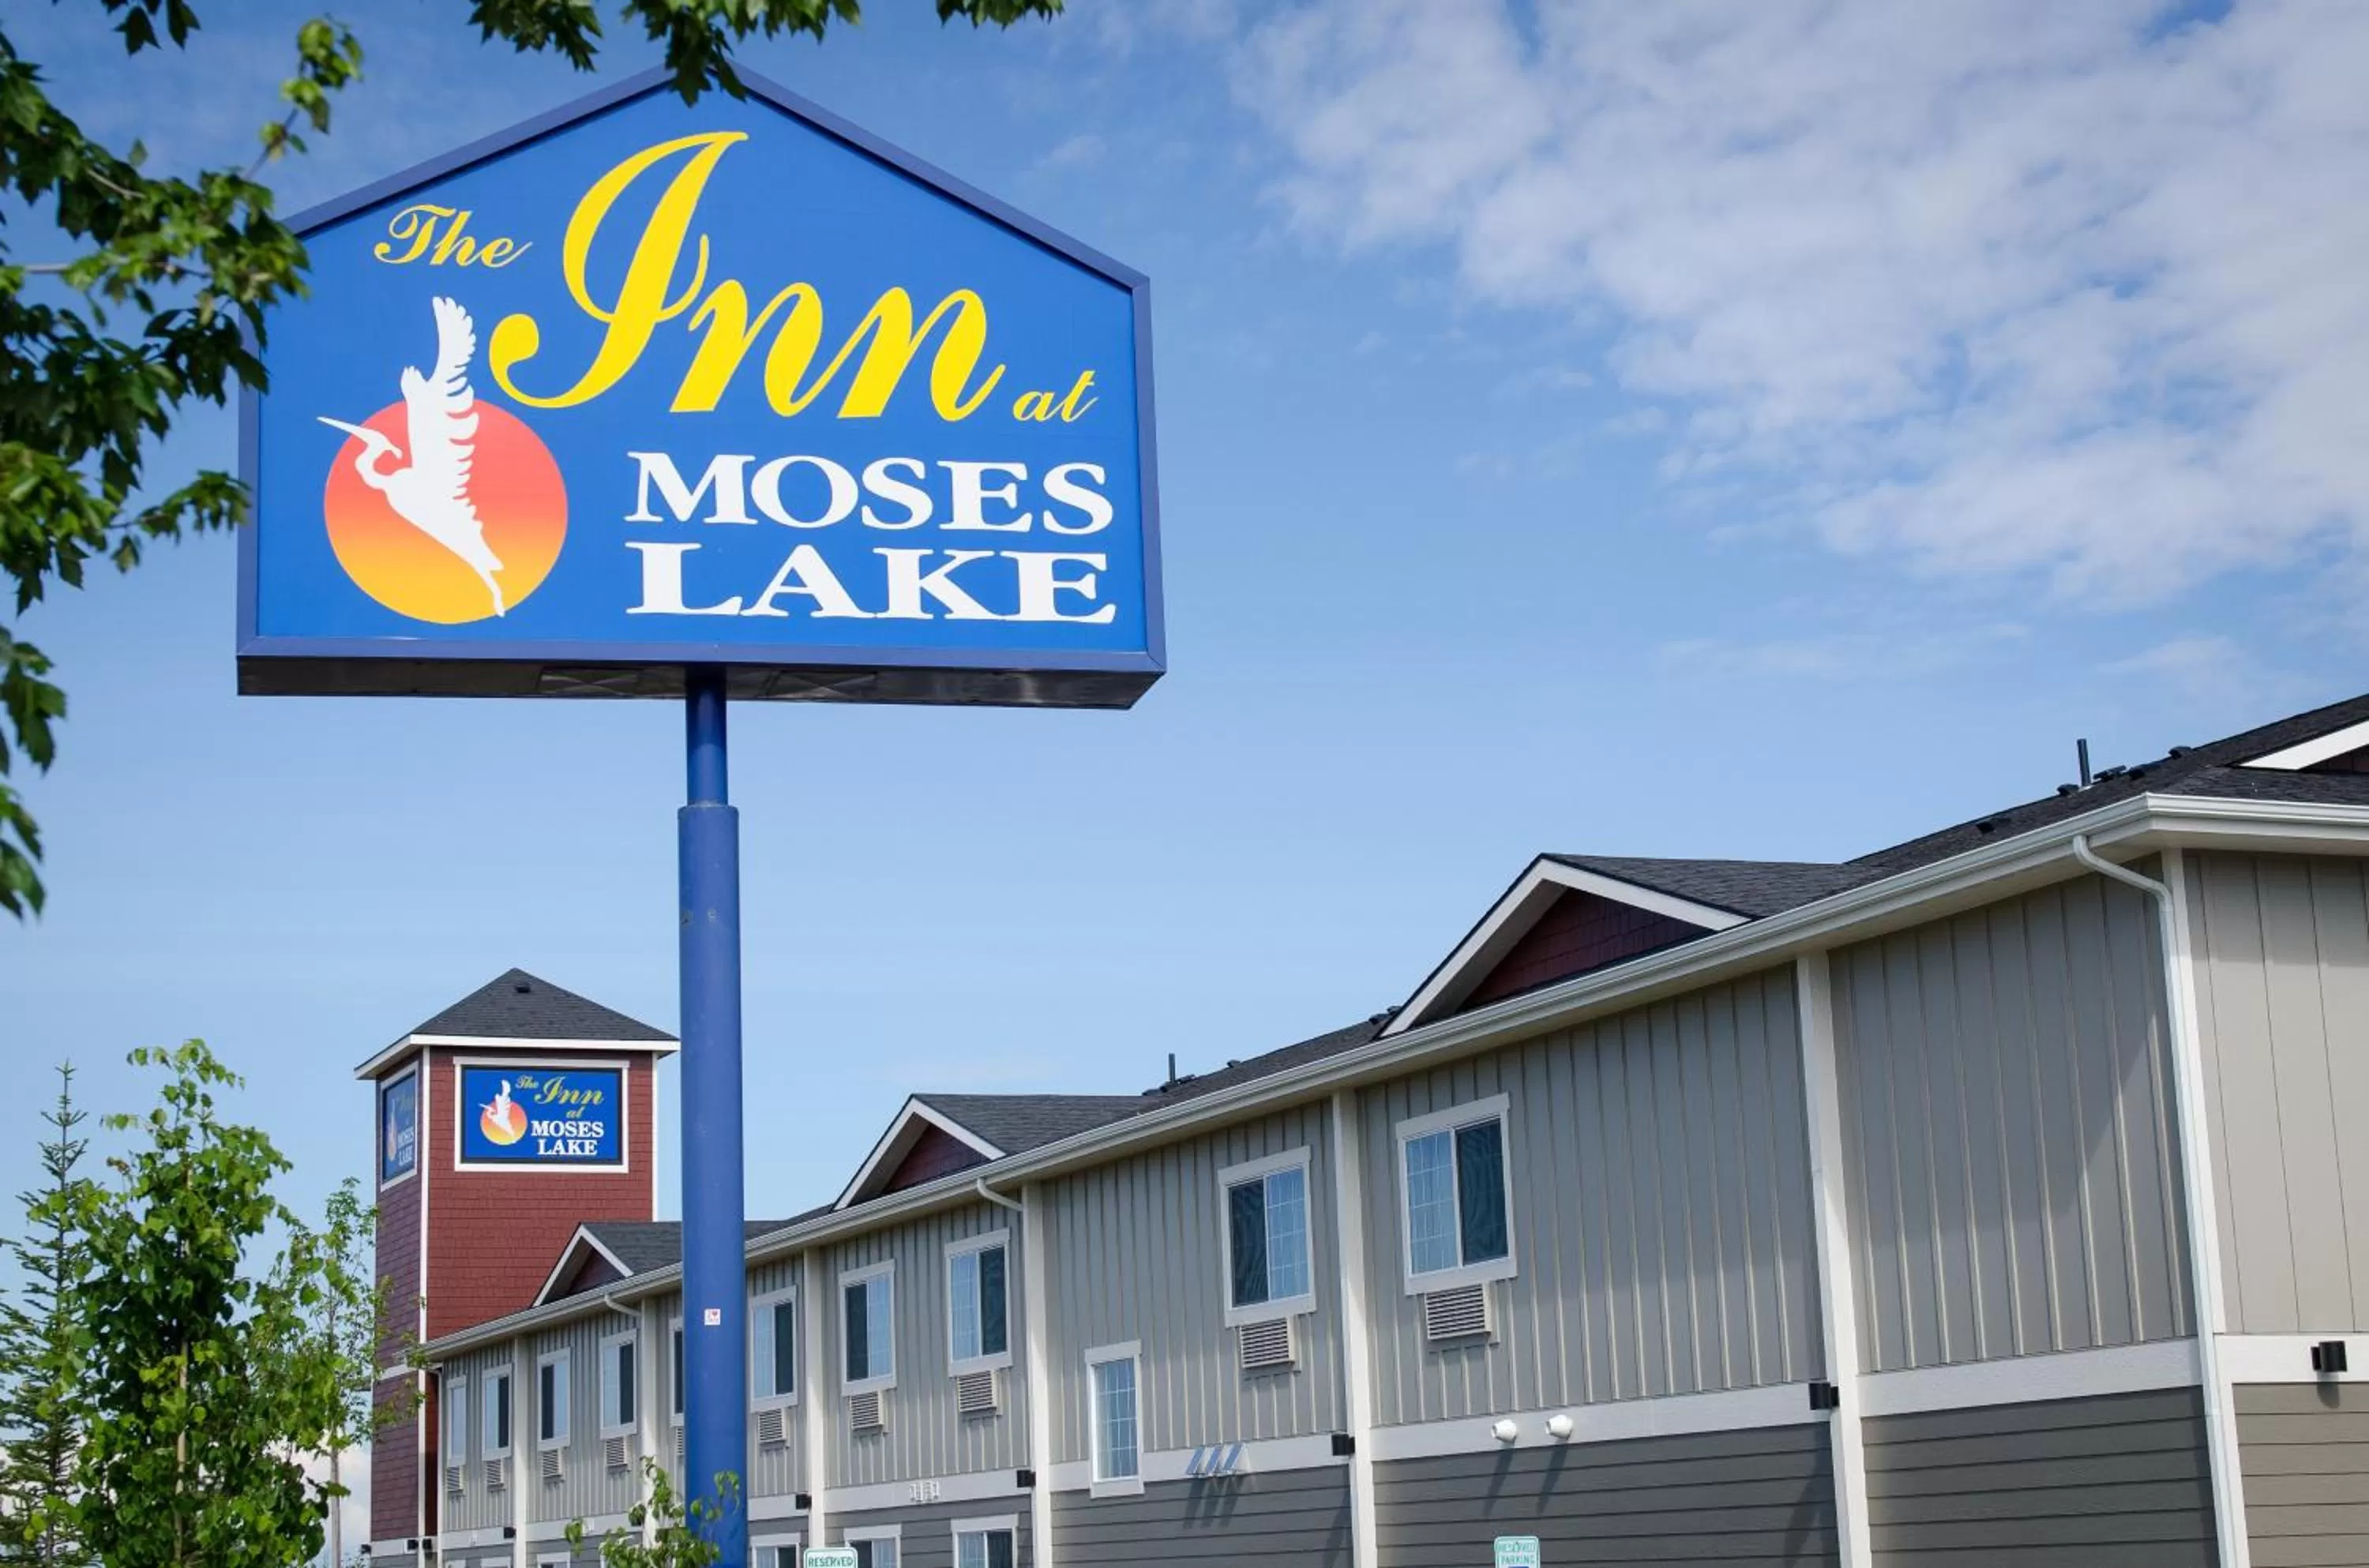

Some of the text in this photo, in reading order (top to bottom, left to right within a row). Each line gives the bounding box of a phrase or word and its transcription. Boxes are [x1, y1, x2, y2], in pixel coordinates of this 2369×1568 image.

[374, 131, 1096, 423] The Inn at
[625, 452, 1114, 535] MOSES
[625, 542, 1116, 624] LAKE
[515, 1075, 604, 1105] The Inn
[565, 1105, 585, 1118] at
[531, 1120, 604, 1137] MOSES
[537, 1138, 598, 1156] LAKE
[808, 1556, 854, 1567] RESERVED
